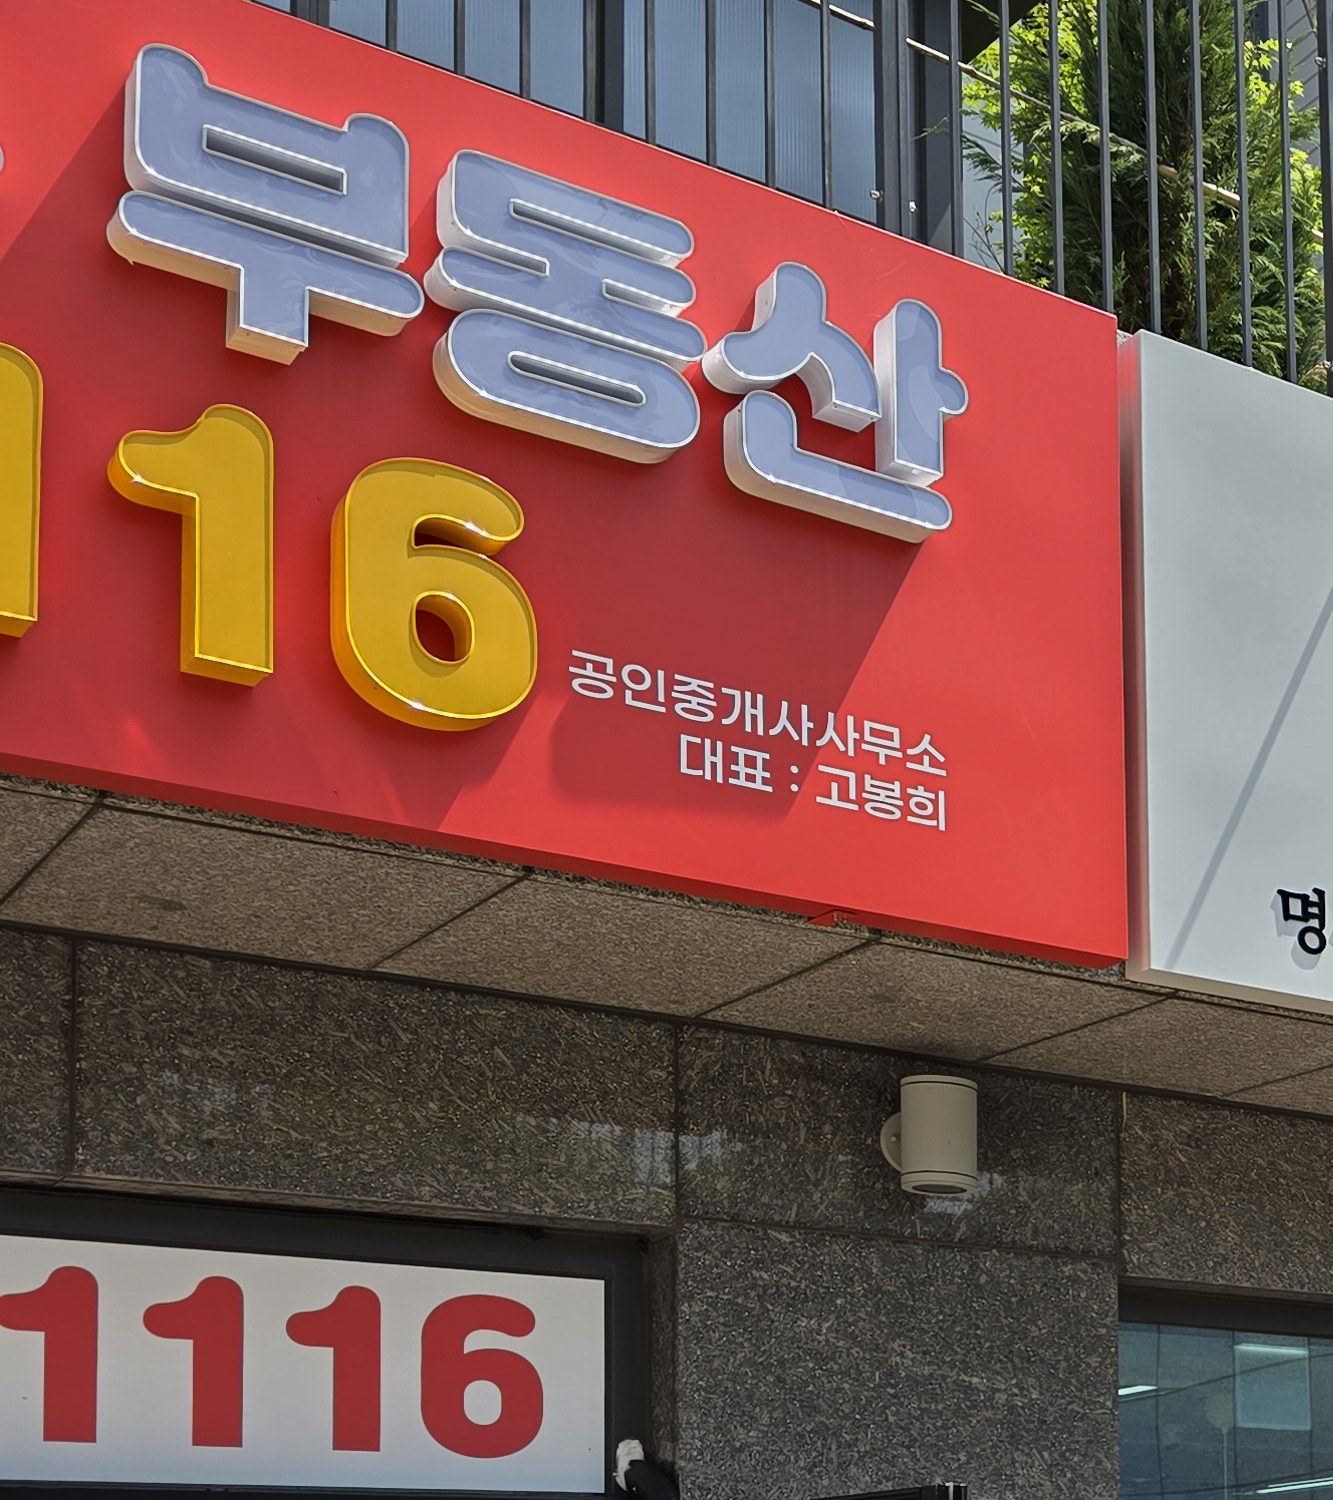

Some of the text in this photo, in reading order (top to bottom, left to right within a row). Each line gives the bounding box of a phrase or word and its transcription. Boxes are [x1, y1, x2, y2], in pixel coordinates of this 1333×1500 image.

[108, 42, 969, 544] 부동산
[0, 341, 538, 731] 16
[569, 649, 947, 776] 공인중개사사무소
[680, 733, 774, 793] 대표
[815, 764, 946, 831] 고봉희
[0, 1265, 544, 1460] 1116
